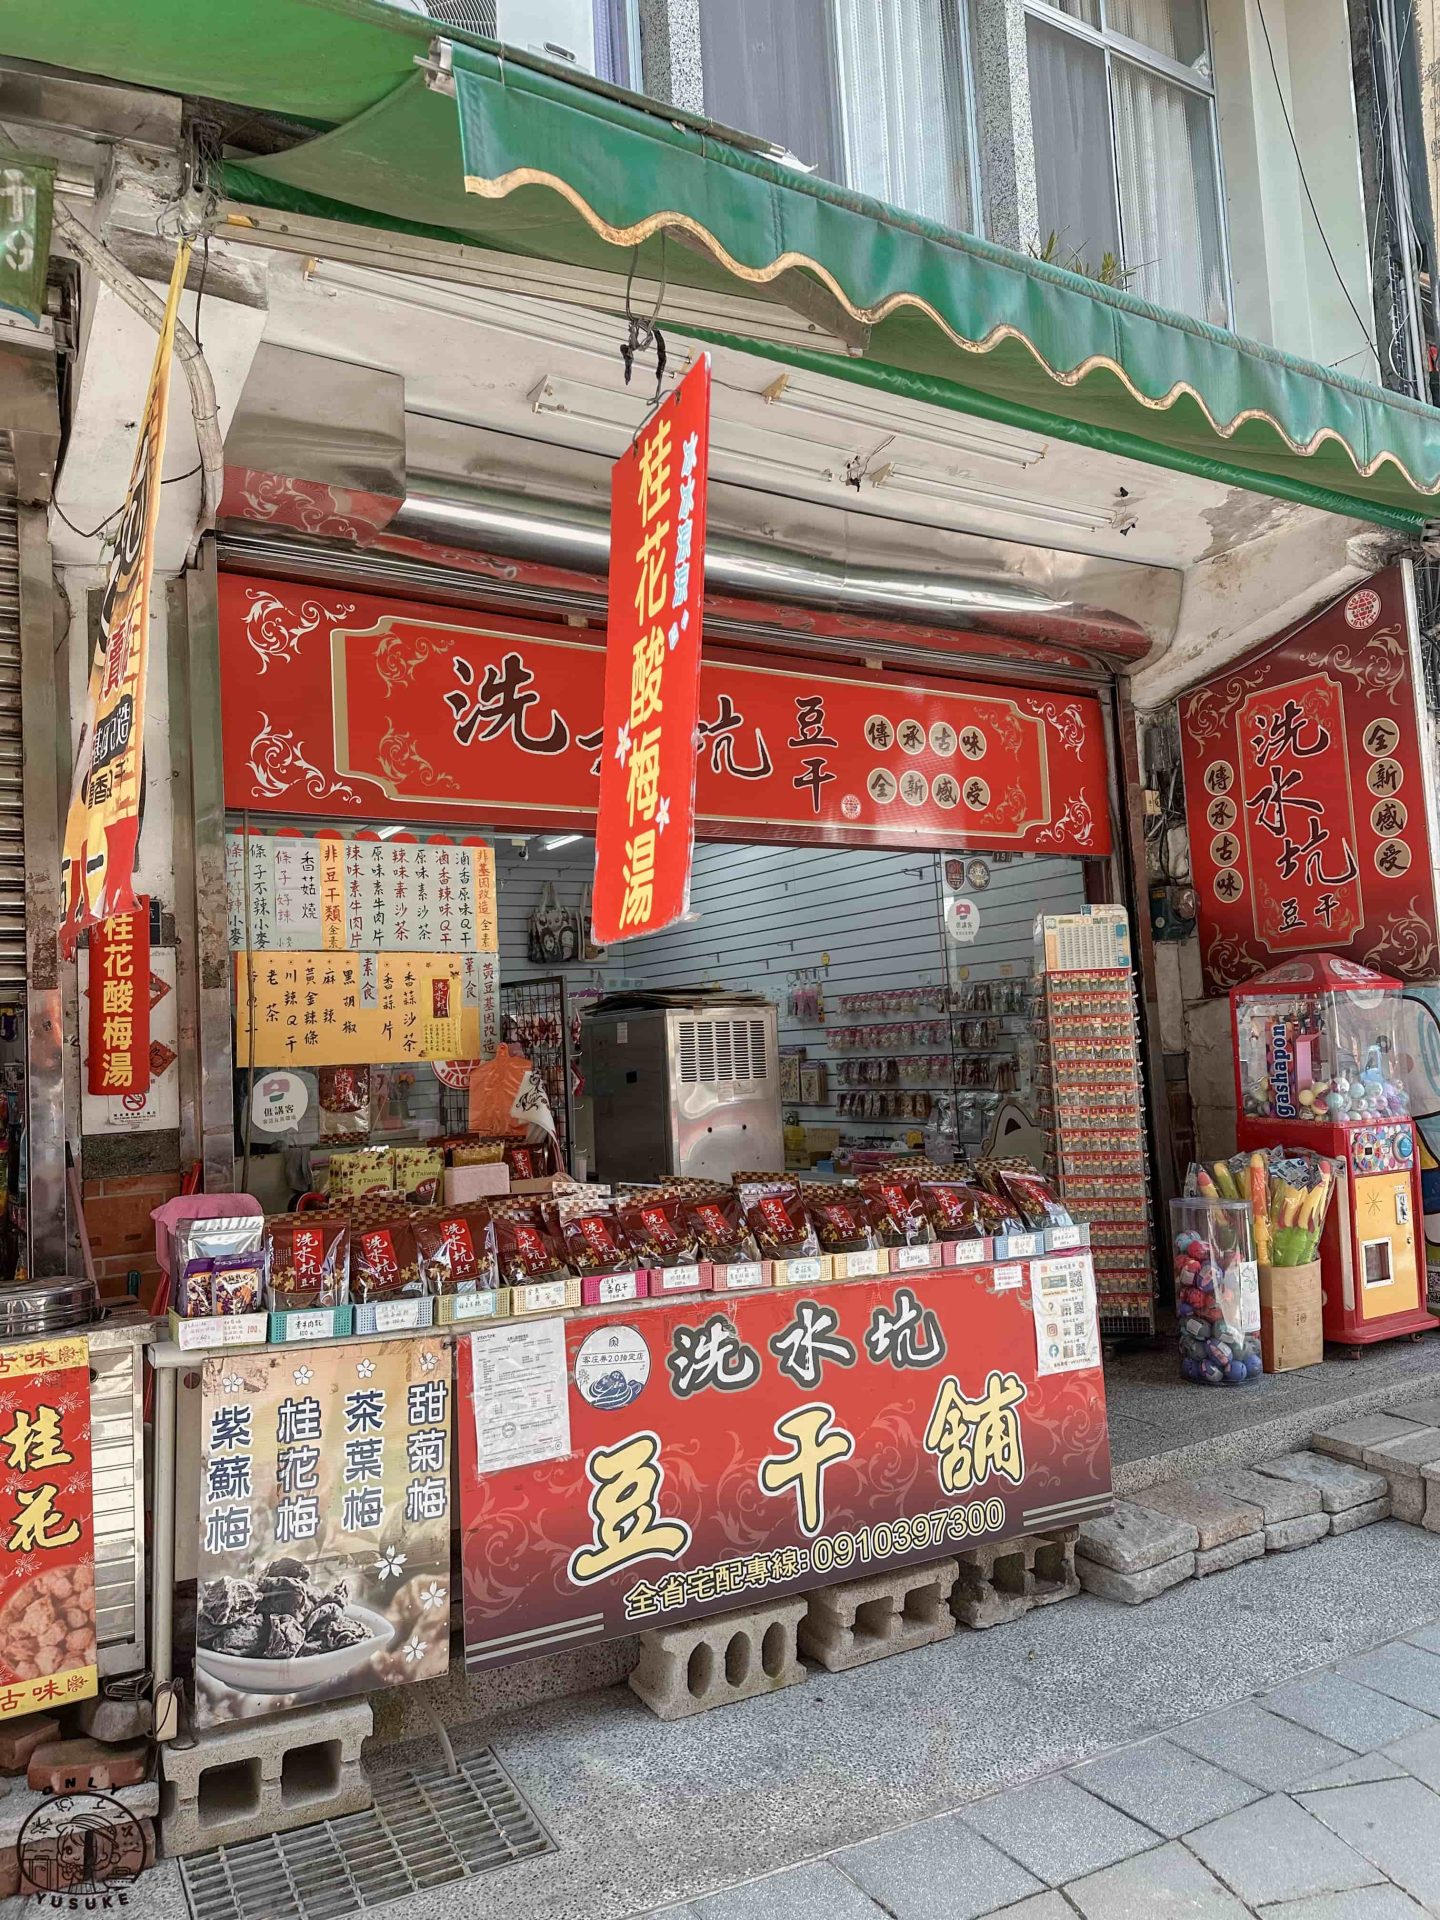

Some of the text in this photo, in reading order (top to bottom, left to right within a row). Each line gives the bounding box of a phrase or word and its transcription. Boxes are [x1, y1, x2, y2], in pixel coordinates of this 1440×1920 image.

[619, 419, 674, 930] 桂花酸梅湯
[788, 696, 838, 813] 豆干
[866, 717, 986, 760] 傳承古味
[868, 770, 989, 809] 全新感受
[1206, 764, 1241, 898] 傳承古味
[1246, 699, 1359, 886] 洗水坑
[1365, 721, 1410, 874] 全新感受
[1278, 894, 1341, 934] 豆干
[102, 912, 134, 1088] 桂花酸梅湯
[361, 957, 377, 1001] 素食
[1273, 1023, 1296, 1118] gashapon
[294, 1232, 323, 1276] 洗水坑
[365, 1235, 398, 1273] 洗水坑
[443, 1222, 473, 1263] 洗水坑
[516, 1230, 548, 1261] 洗水坑
[645, 1213, 679, 1242] 洗水坑
[764, 1202, 794, 1232] 洗水坑
[668, 1293, 947, 1395] 洗水坑
[6, 1403, 82, 1553] 桂花
[205, 1404, 252, 1554] 紫蘇梅
[276, 1396, 321, 1543] 桂花梅
[342, 1388, 386, 1533] 茶葉梅
[405, 1378, 448, 1522] 甜菊梅
[0, 1679, 65, 1711] 古味
